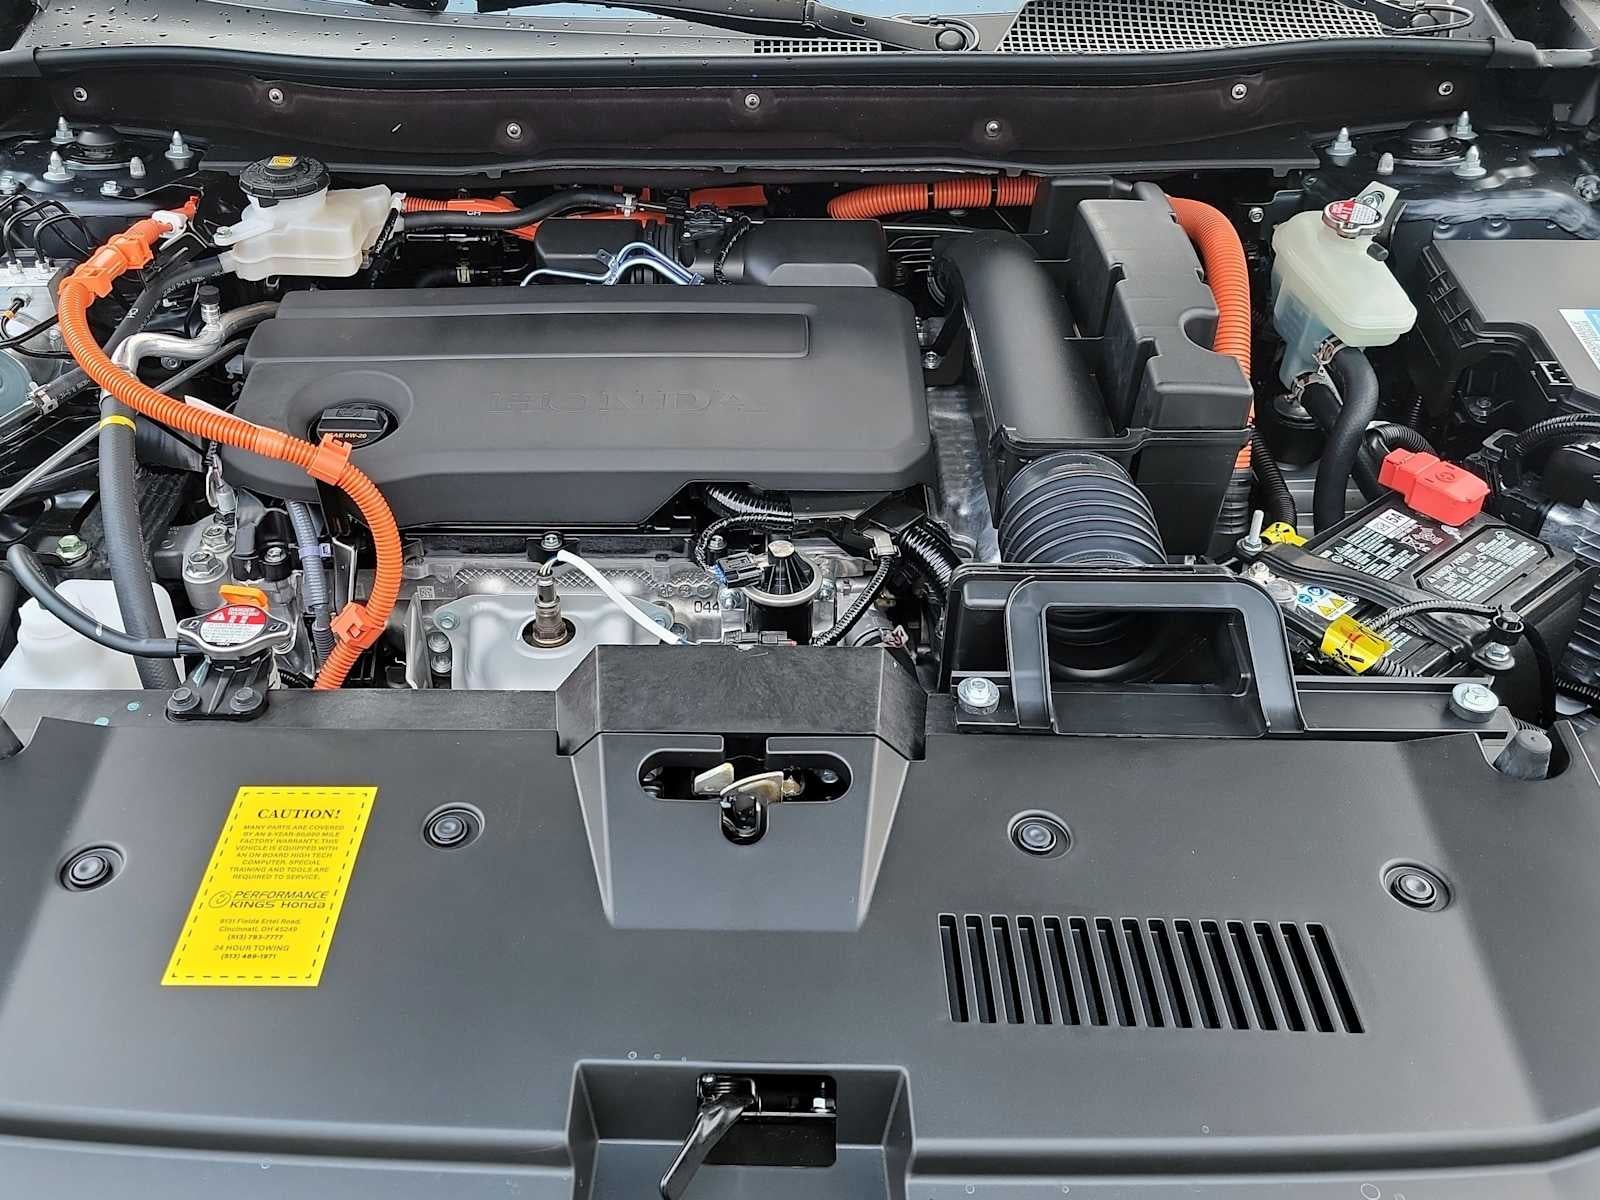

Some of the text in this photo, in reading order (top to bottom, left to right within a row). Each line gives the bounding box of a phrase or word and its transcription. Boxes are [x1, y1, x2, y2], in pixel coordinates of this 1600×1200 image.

[257, 808, 341, 819] CAUTION!
[233, 890, 329, 899] PERFORMANCE
[230, 901, 326, 909] KINGS Honda
